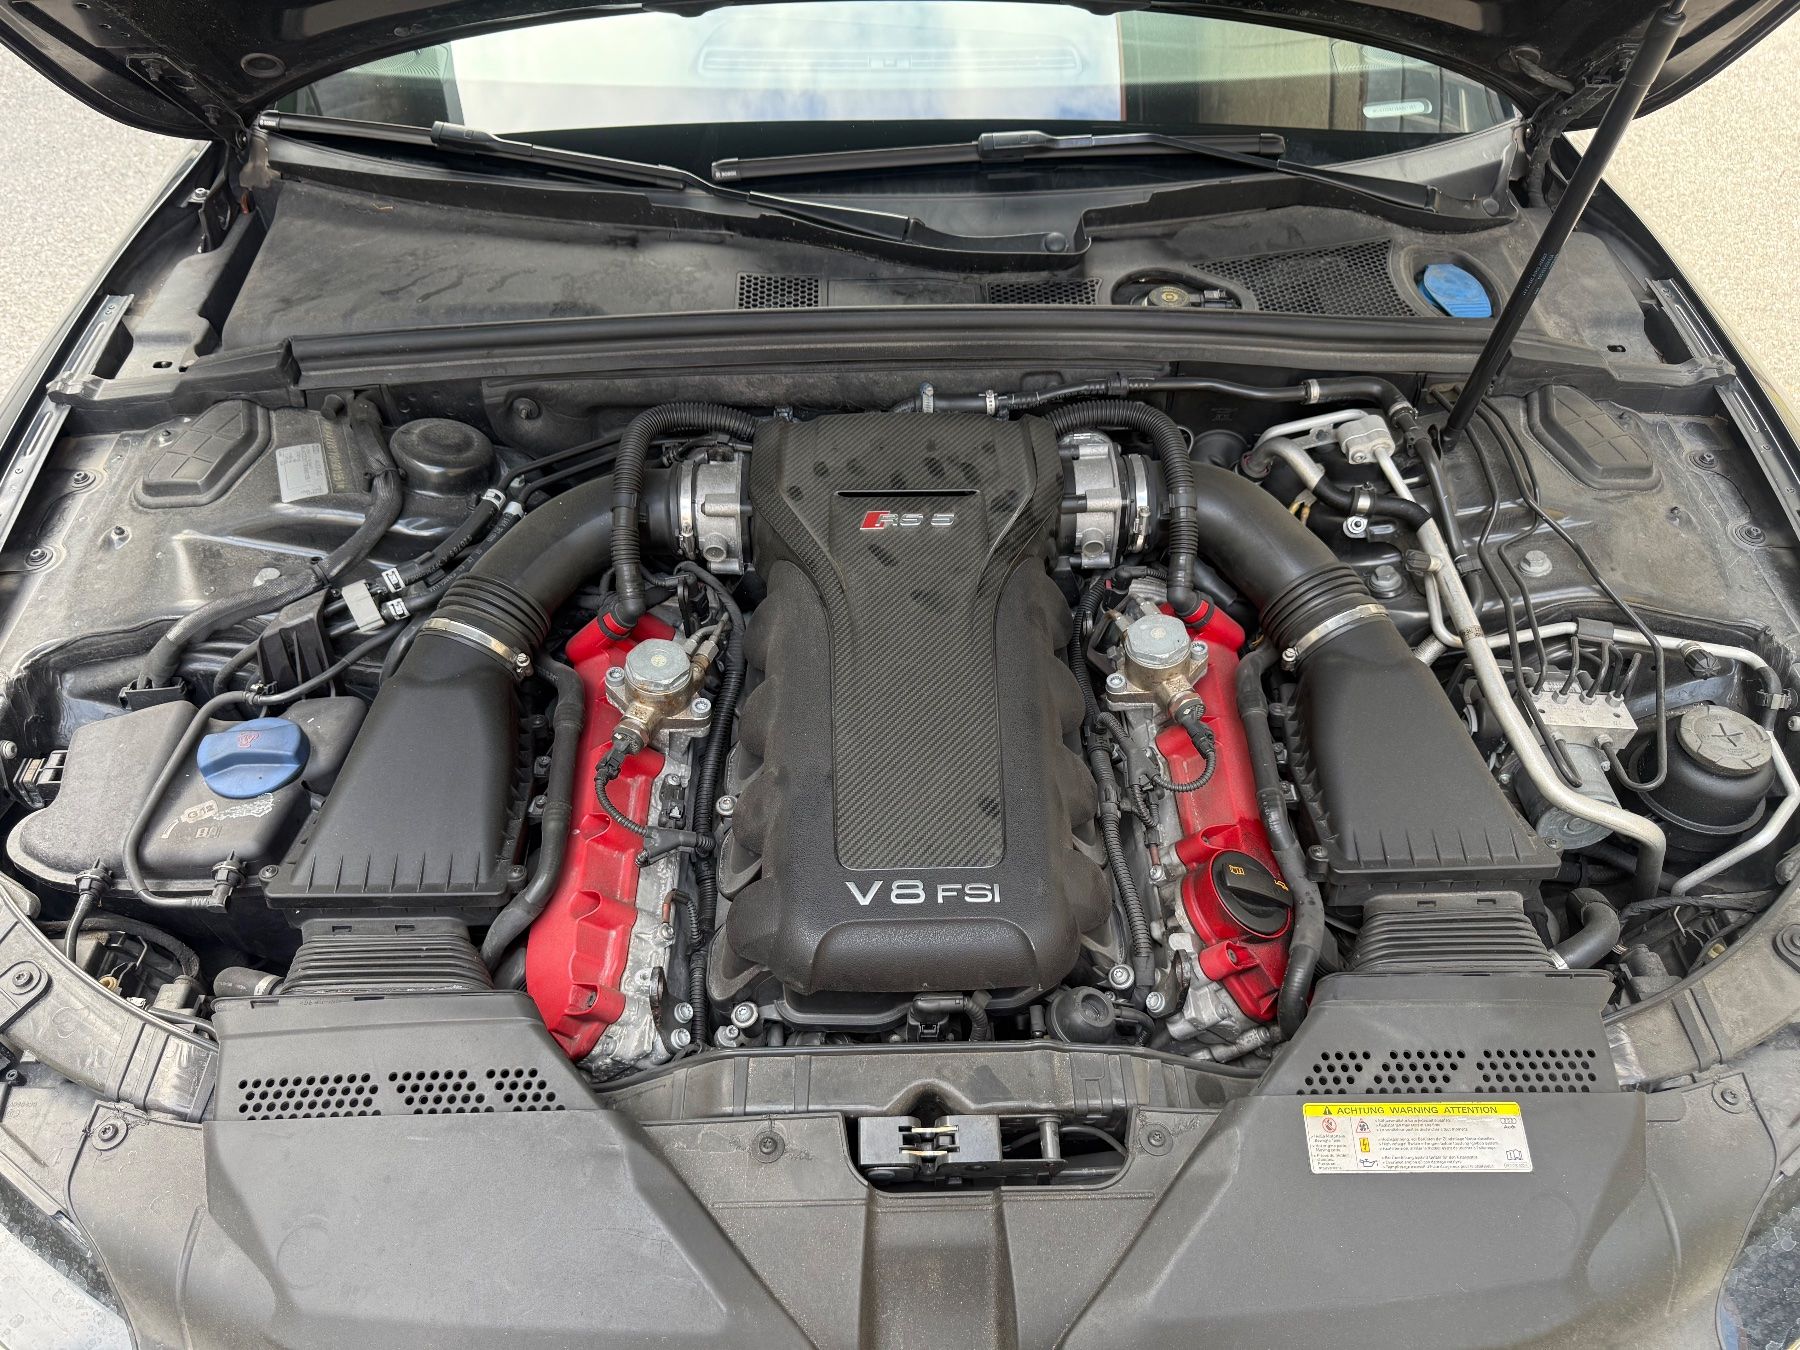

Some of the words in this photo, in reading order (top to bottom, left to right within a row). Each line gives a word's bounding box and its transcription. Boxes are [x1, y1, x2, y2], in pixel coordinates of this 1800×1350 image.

[930, 513, 955, 527] 5
[844, 879, 926, 906] V8
[936, 882, 1001, 904] FSI
[1336, 1106, 1386, 1115] ACHTUNG
[1389, 1105, 1439, 1114] WARNING
[1443, 1105, 1498, 1114] ATTENTION
